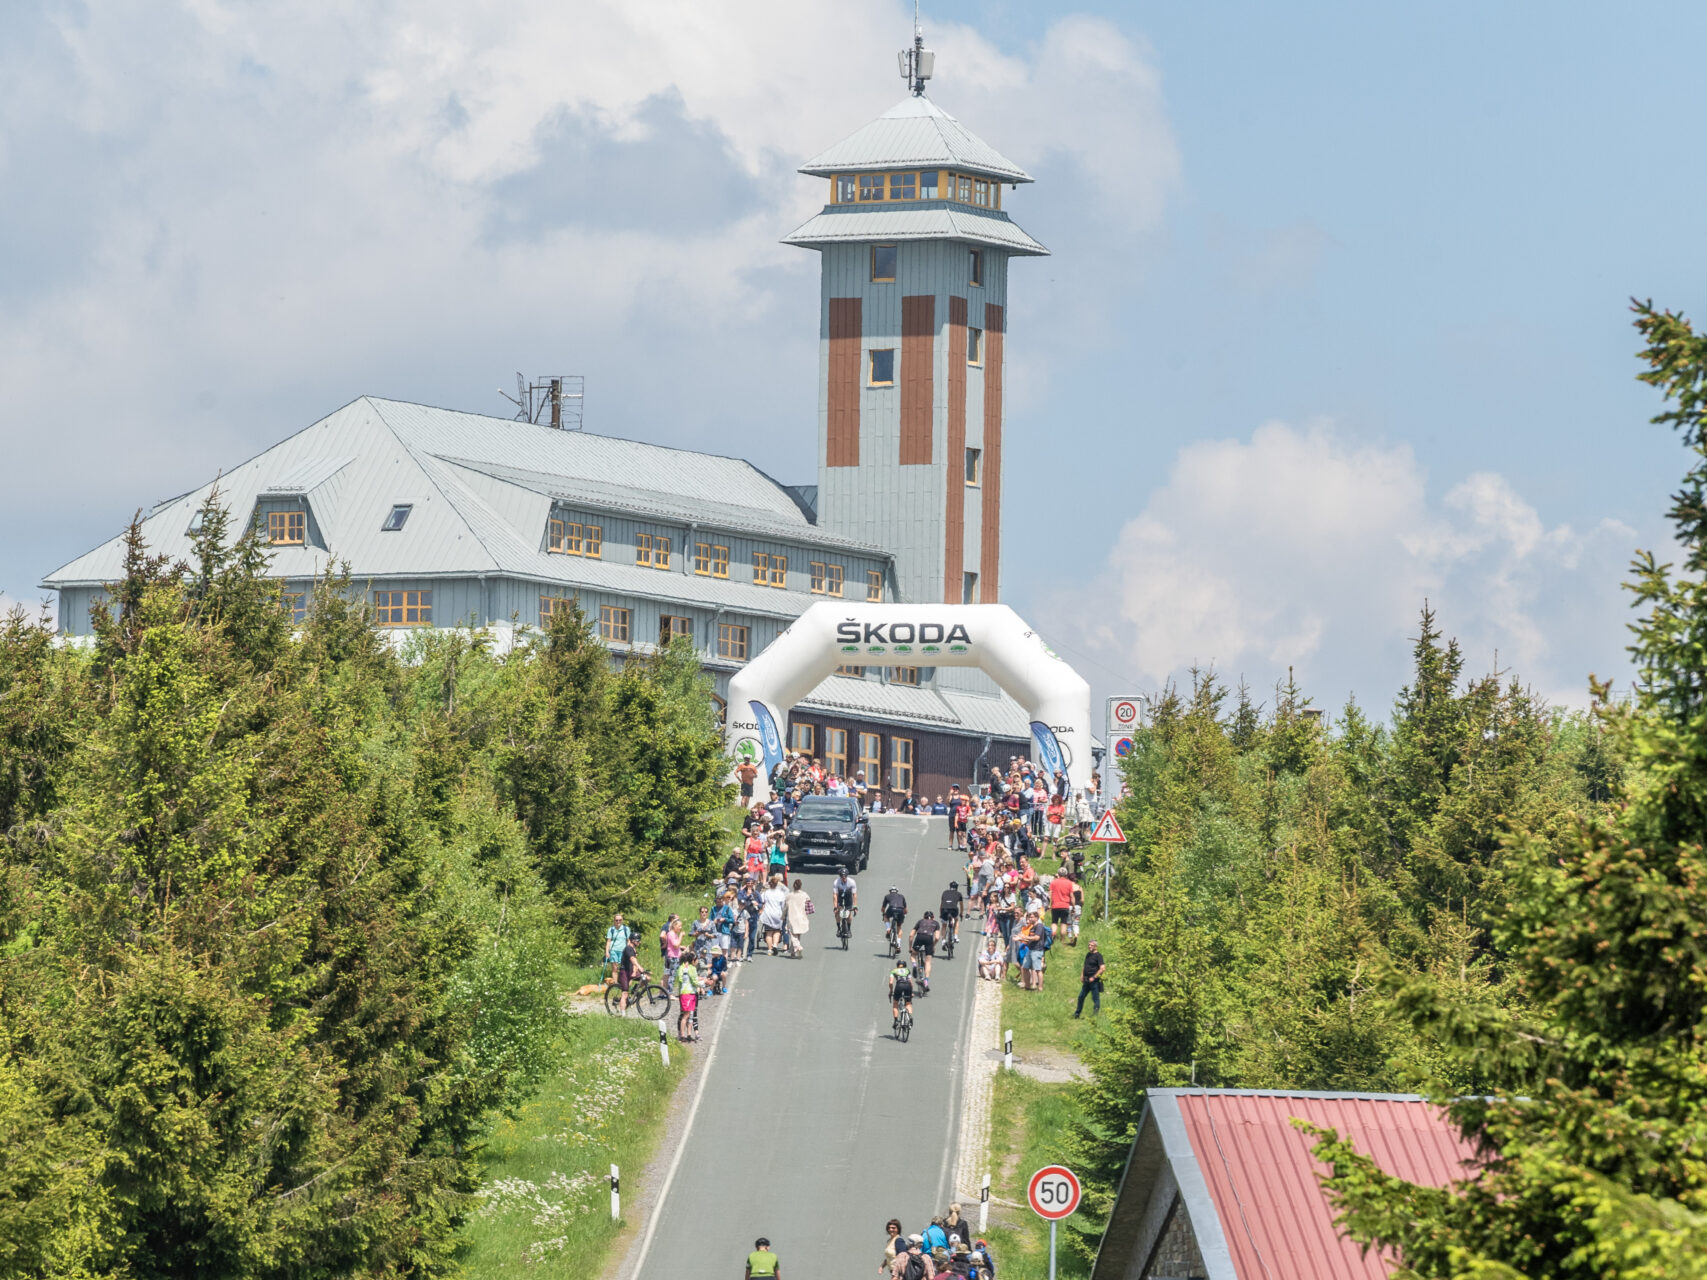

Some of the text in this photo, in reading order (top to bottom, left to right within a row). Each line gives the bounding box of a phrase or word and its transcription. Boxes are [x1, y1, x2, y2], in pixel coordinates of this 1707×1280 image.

[836, 617, 973, 644] ŠKODA
[1120, 707, 1132, 717] 20
[732, 721, 760, 731] ŠKOD
[1041, 1181, 1069, 1204] 50
